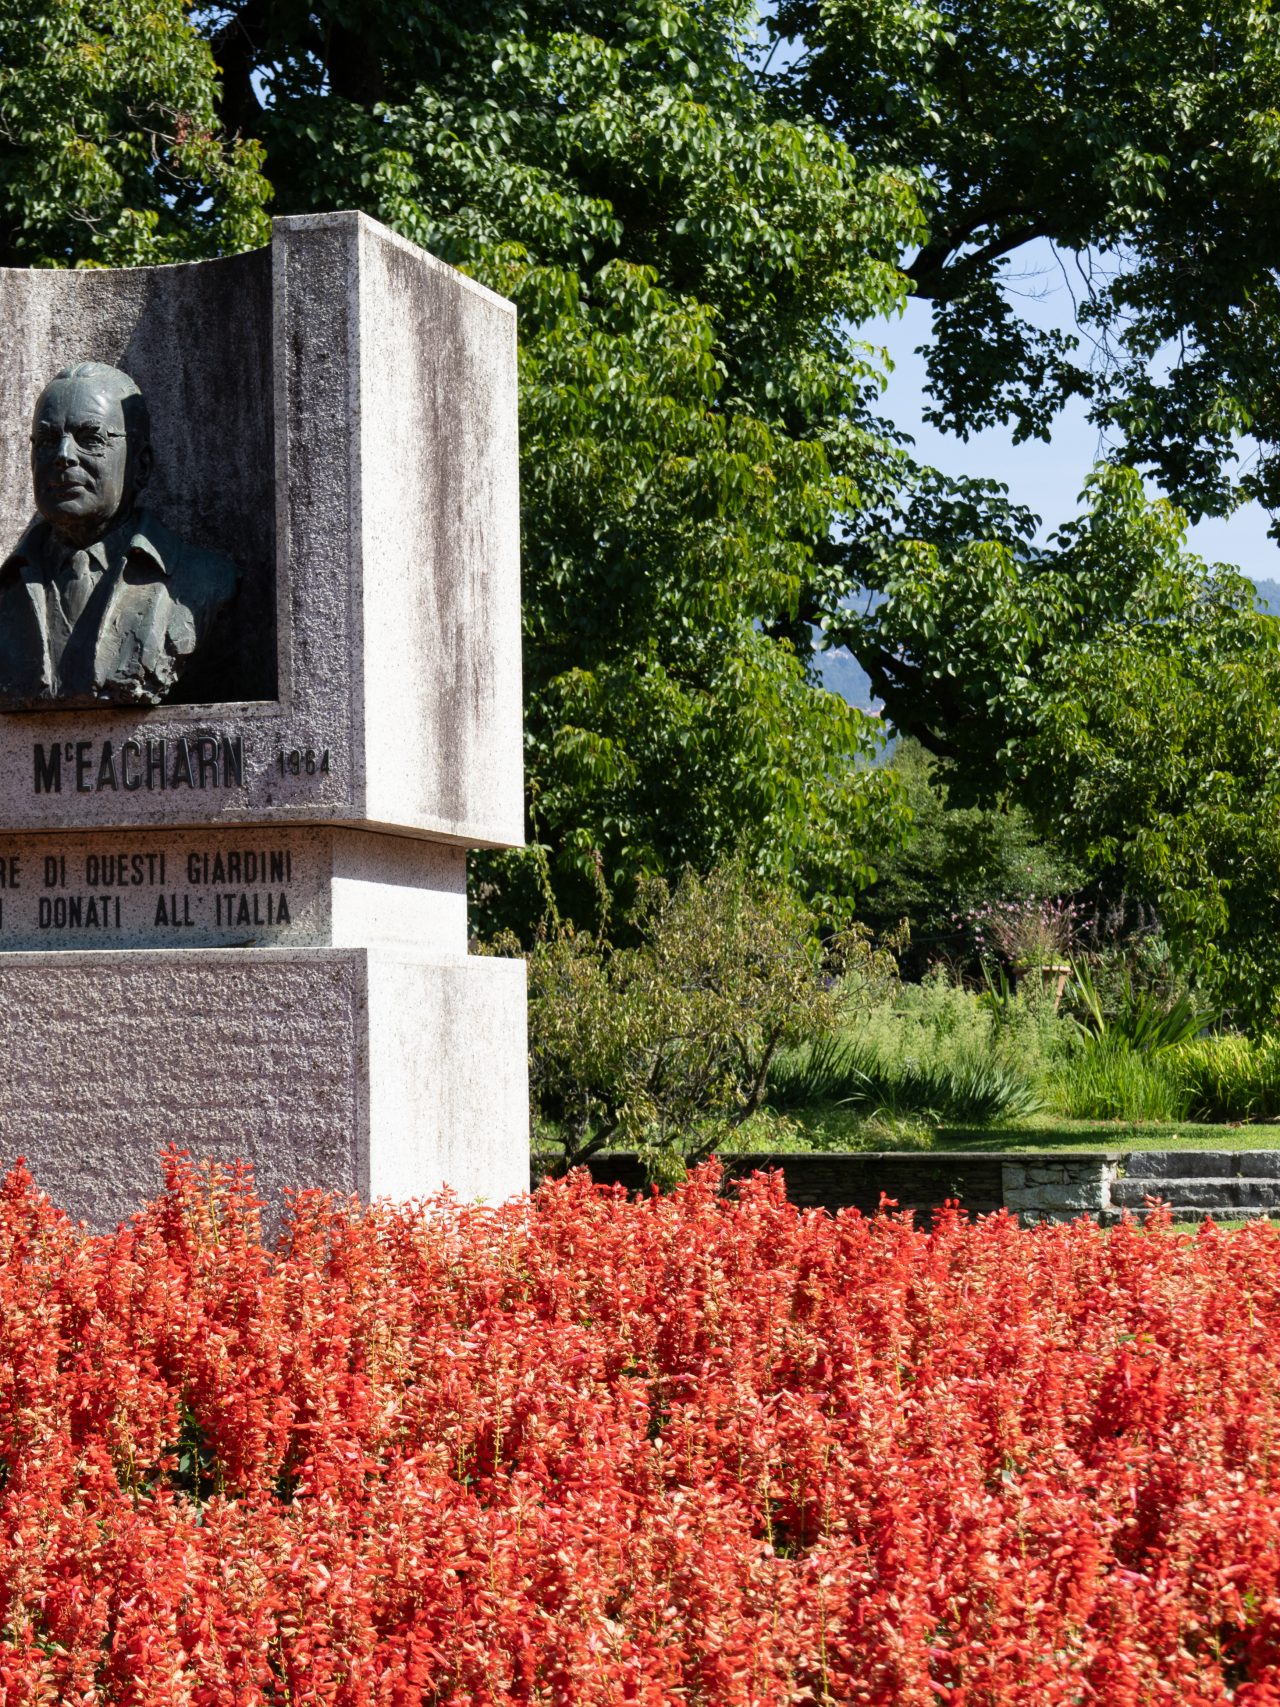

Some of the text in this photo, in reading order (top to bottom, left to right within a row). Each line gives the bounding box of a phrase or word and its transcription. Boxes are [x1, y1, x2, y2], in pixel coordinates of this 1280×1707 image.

[280, 749, 331, 778] 1964
[44, 855, 66, 888] DI
[86, 853, 166, 887] QUESTI
[187, 850, 292, 885] GIARDINI
[38, 895, 121, 929] DONATI
